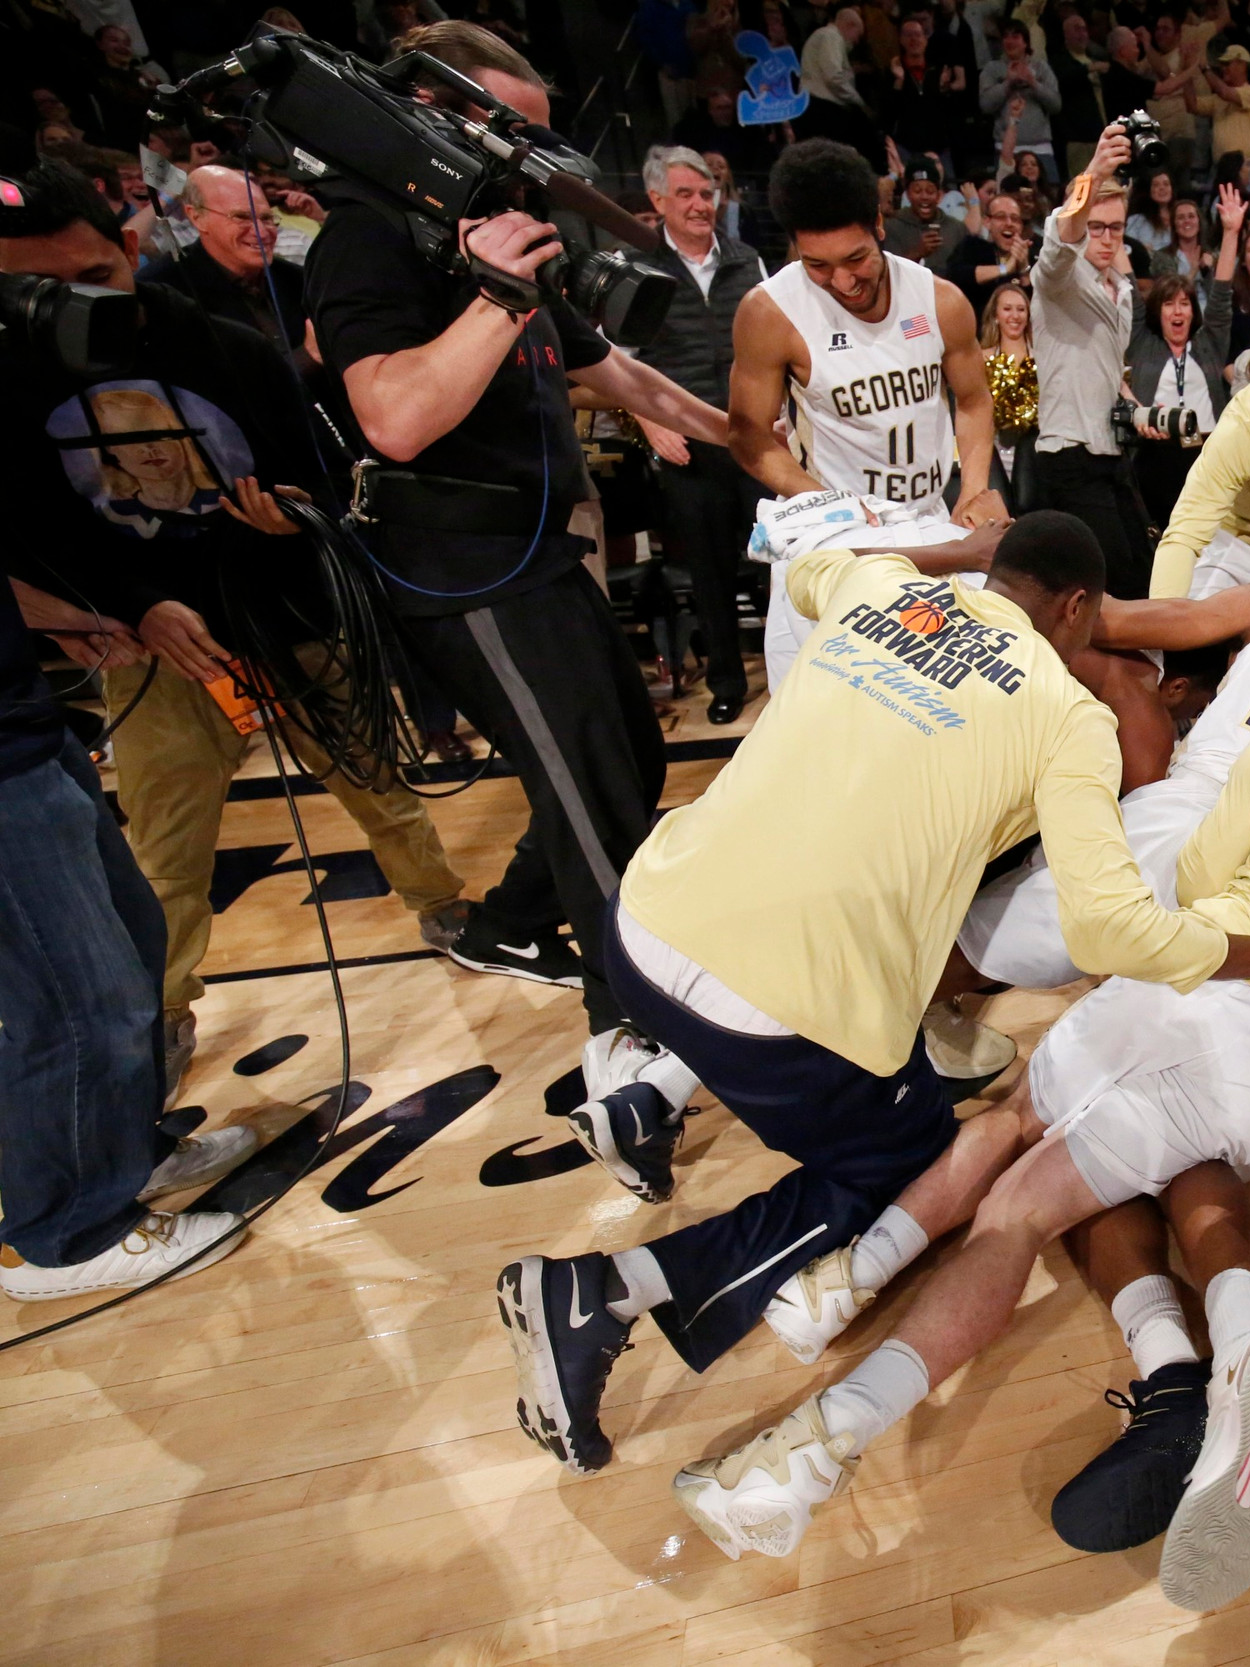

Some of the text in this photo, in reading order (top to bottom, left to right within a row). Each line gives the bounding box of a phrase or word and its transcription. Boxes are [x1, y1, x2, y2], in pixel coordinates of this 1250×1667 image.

[430, 158, 463, 180] SONY
[828, 344, 854, 352] RUSSELL
[831, 363, 940, 418] GEORGIA
[888, 421, 914, 466] 11
[863, 458, 942, 503] TECH
[839, 603, 972, 690] FORWARD
[820, 633, 966, 730] for Autism
[861, 685, 900, 713] AUTISM
[897, 707, 937, 737] SPEAKS
